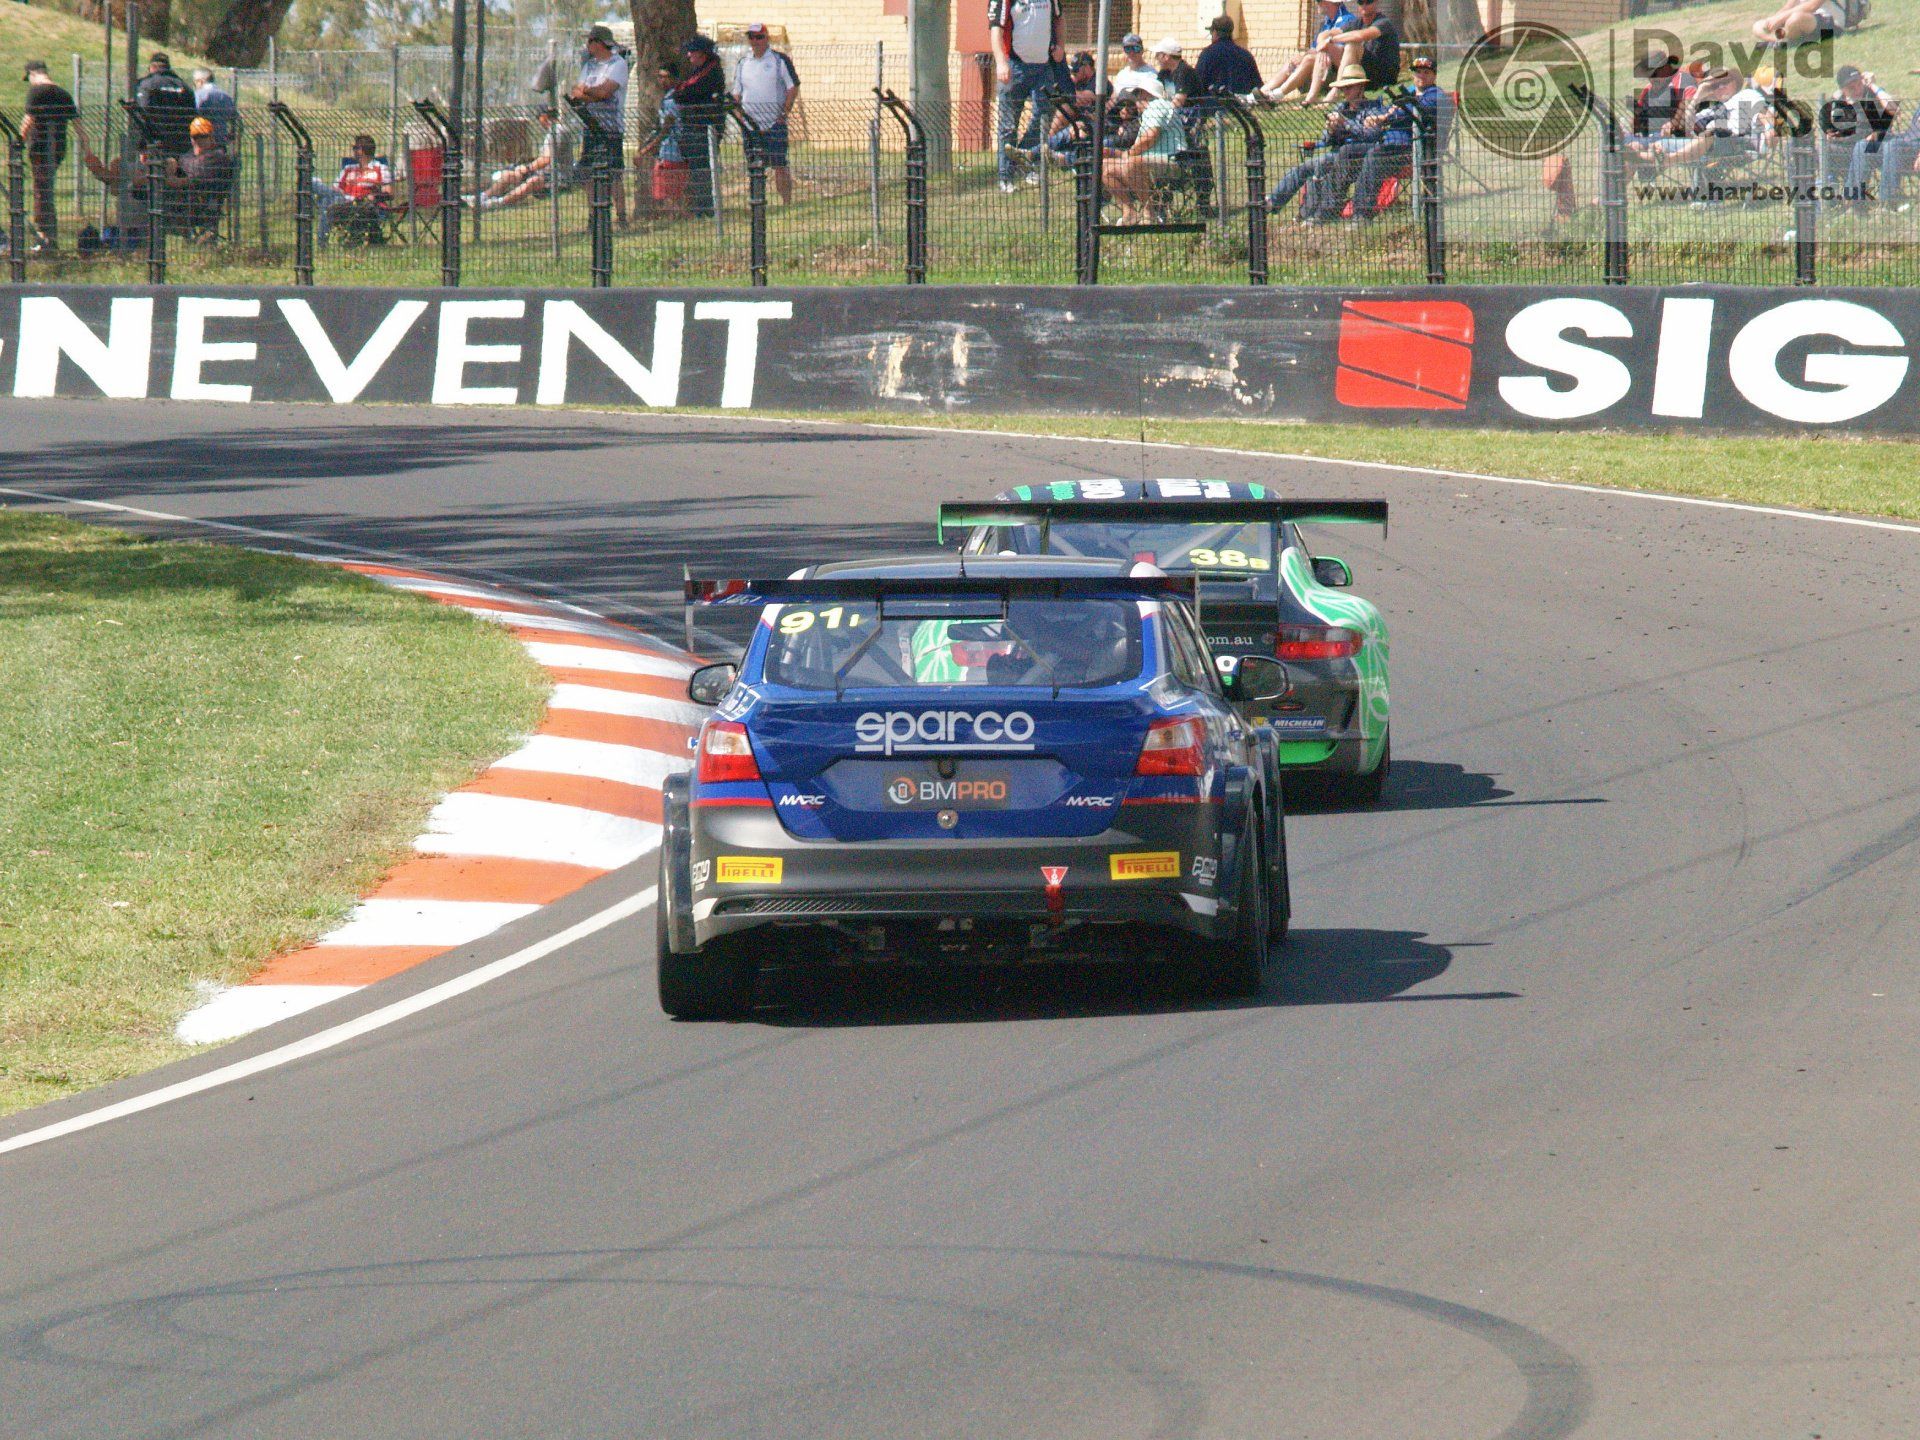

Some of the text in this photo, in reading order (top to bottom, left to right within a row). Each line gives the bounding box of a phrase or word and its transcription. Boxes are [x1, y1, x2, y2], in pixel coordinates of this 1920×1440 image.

[0, 295, 794, 409] NEVENT
[1498, 298, 1910, 424] SIG
[1205, 635, 1254, 646] om.au
[1273, 719, 1325, 728] MICHELIN
[854, 710, 1036, 756] sparco
[919, 780, 1007, 801] BMPRO
[778, 794, 826, 806] MARC
[1065, 795, 1115, 807] MARC
[721, 862, 775, 878] PIRELLI
[1117, 857, 1175, 874] PIRELLI
